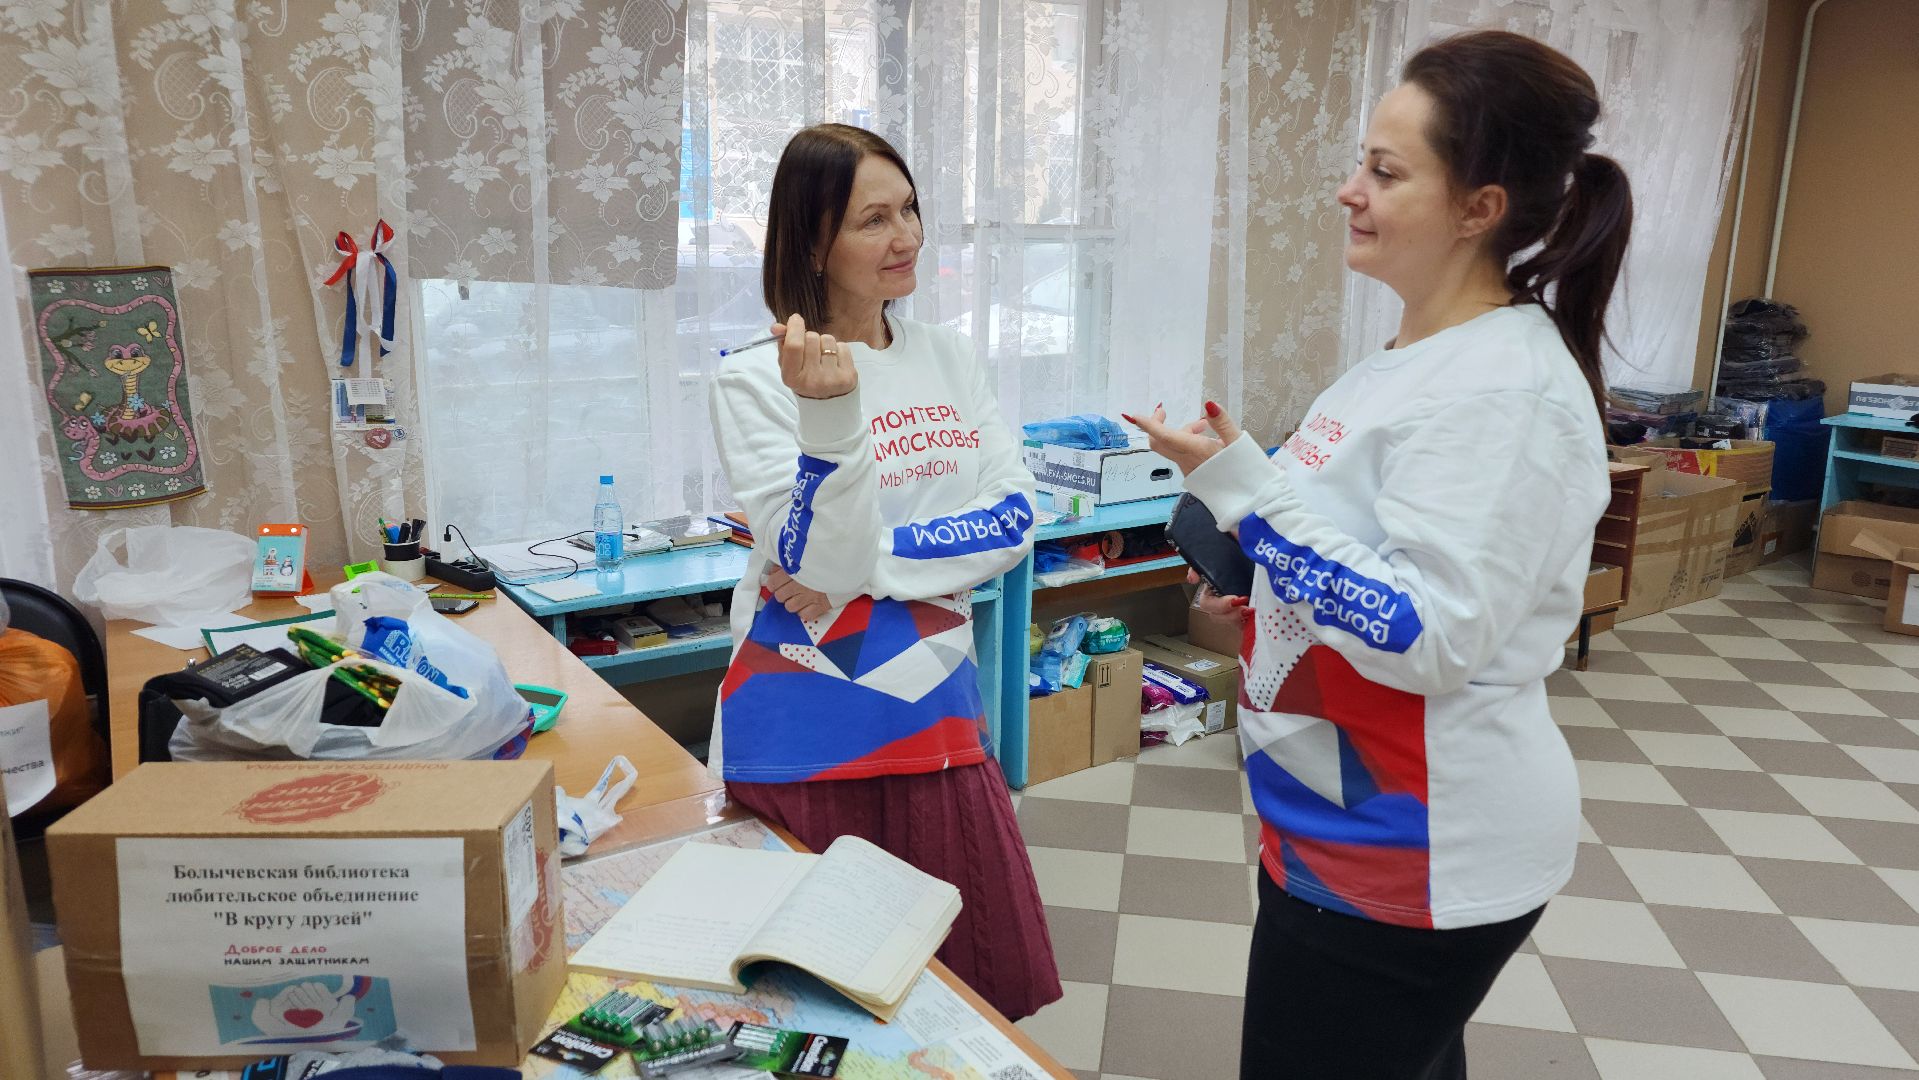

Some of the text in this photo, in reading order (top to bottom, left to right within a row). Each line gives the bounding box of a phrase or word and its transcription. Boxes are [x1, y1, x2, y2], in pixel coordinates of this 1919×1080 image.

[870, 404, 962, 435] ЛОНТЕРЫ
[880, 460, 958, 489] МЫ РЯДОМ
[911, 516, 1003, 547] РЯДОМ
[173, 864, 410, 880] Болычевская библиотека
[165, 887, 419, 904] любительское объединение
[213, 910, 373, 930] "В кругу друзей"
